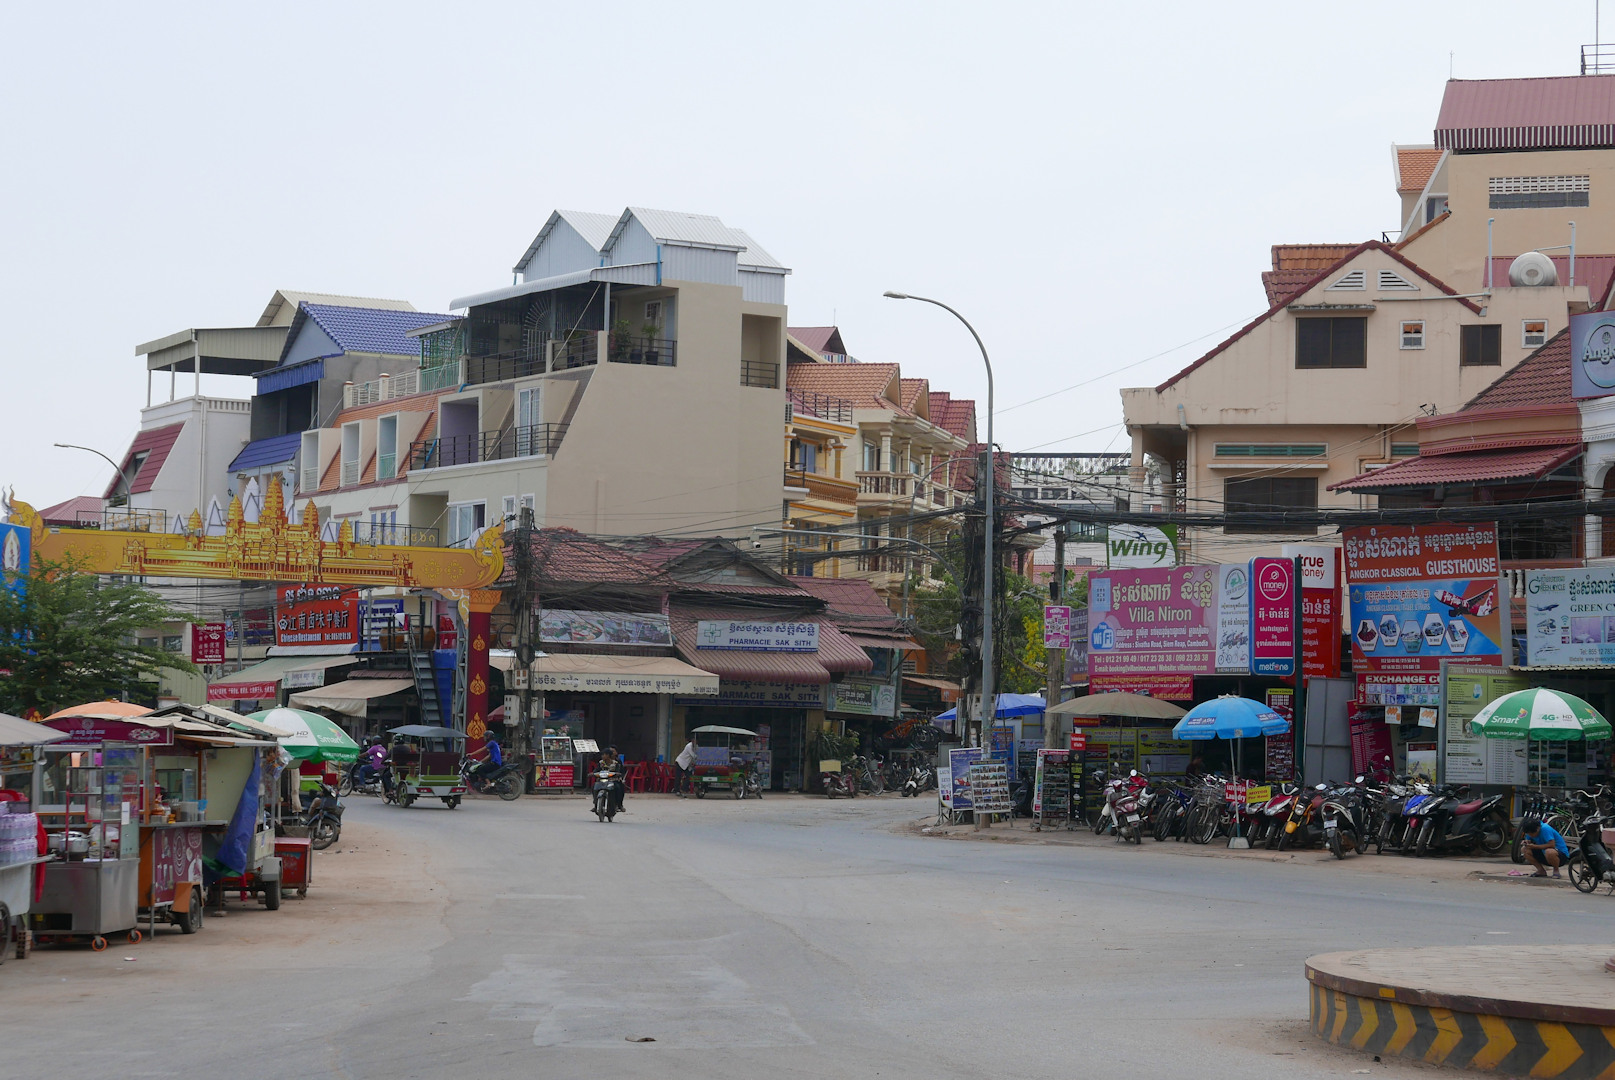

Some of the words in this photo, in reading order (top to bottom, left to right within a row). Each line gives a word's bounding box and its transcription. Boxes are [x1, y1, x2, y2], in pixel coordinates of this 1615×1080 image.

[1111, 540, 1168, 564] Wing
[1426, 557, 1496, 576] GUESTHOUSE
[1350, 568, 1380, 580] ANGKOR
[1381, 566, 1422, 578] CLASSICAL
[1264, 582, 1285, 590] money
[1570, 604, 1602, 612] GREEN
[1128, 606, 1154, 622] Villa
[1158, 606, 1192, 621] Niron
[729, 638, 771, 646] PHARMACIE
[1259, 662, 1288, 671] metfone
[1366, 675, 1426, 684] EXCHANGE
[1491, 716, 1520, 724] Smart
[1579, 717, 1599, 726] Smart
[317, 734, 344, 744] Smart
